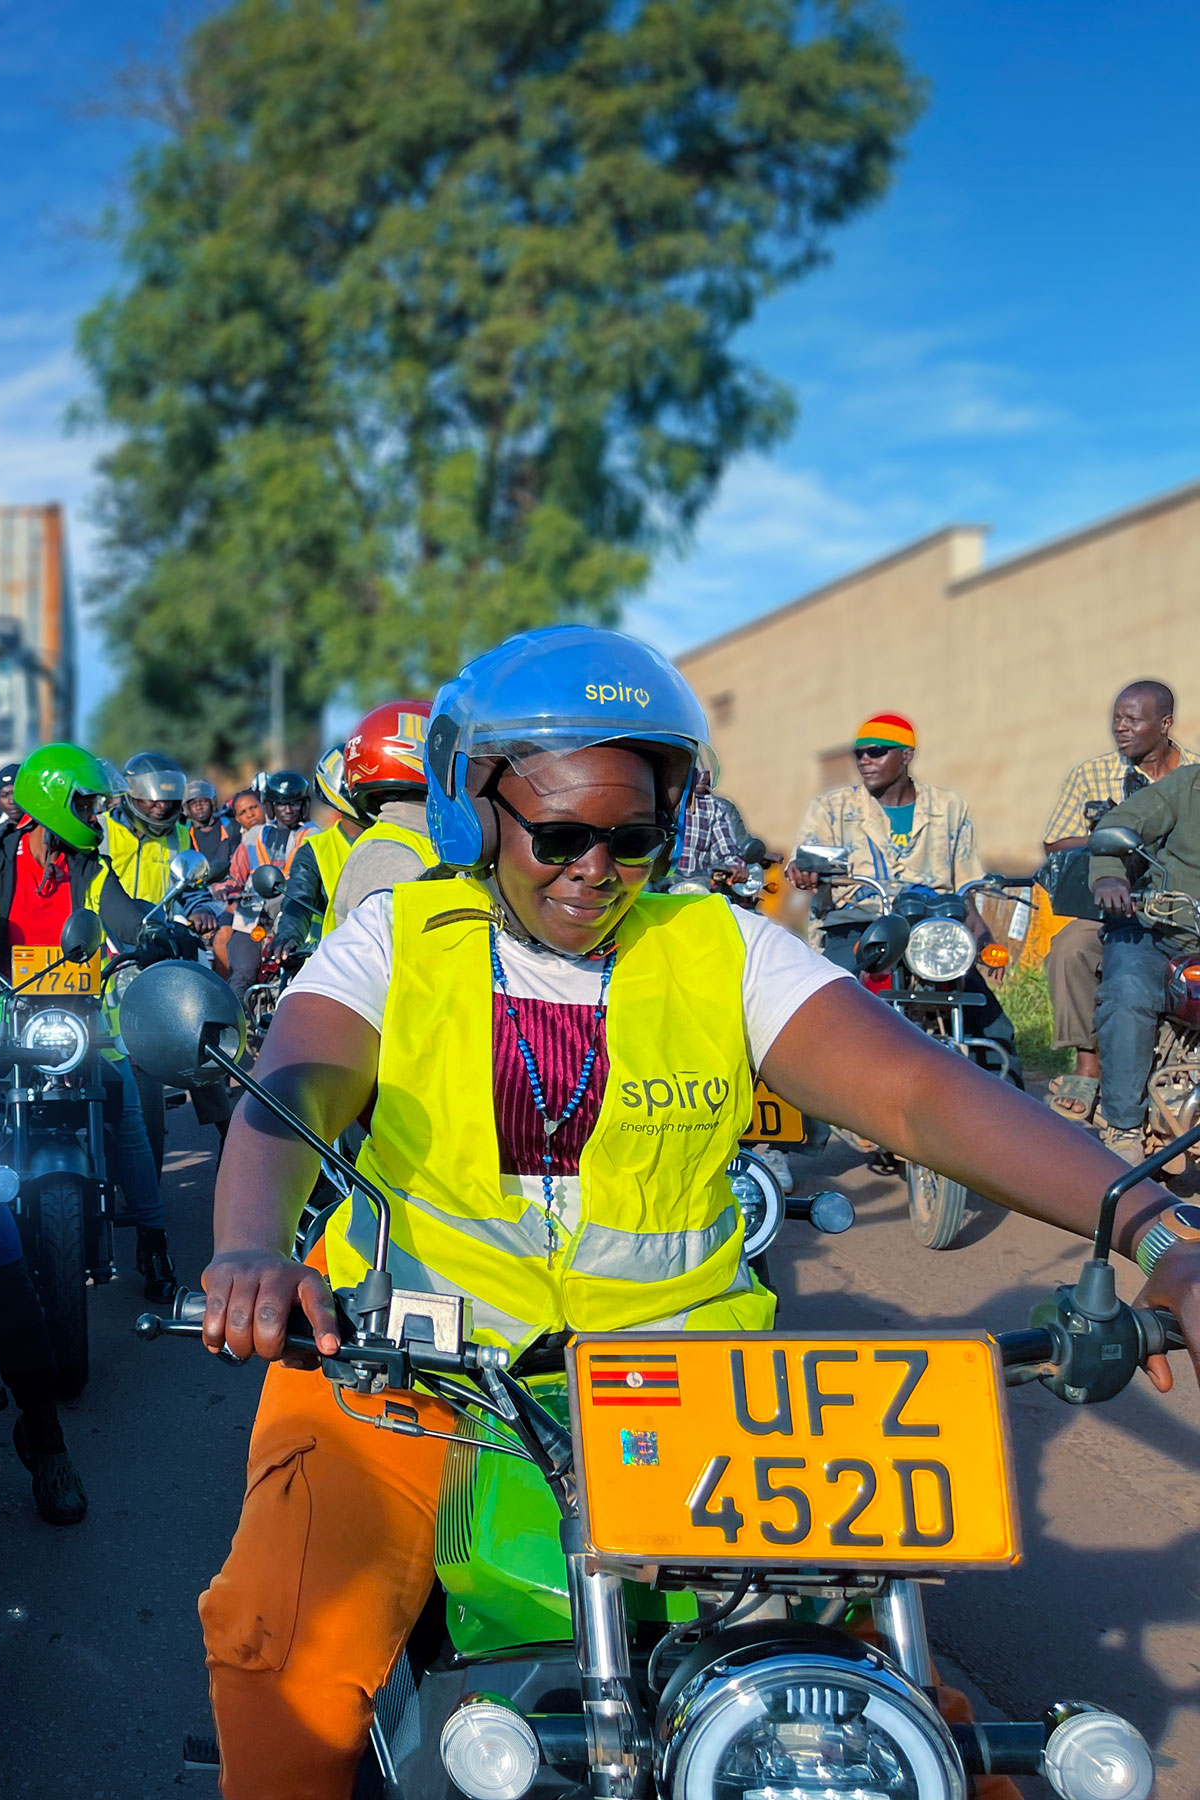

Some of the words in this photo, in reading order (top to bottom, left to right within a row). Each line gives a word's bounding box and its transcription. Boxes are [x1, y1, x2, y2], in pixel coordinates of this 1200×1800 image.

[585, 681, 650, 708] spiro
[34, 971, 91, 992] 774D
[621, 1073, 729, 1116] spiro
[620, 1122, 660, 1136] Energy
[661, 1123, 674, 1131] on
[677, 1122, 693, 1132] the
[730, 1350, 940, 1437] UFZ
[685, 1456, 954, 1547] 452D
